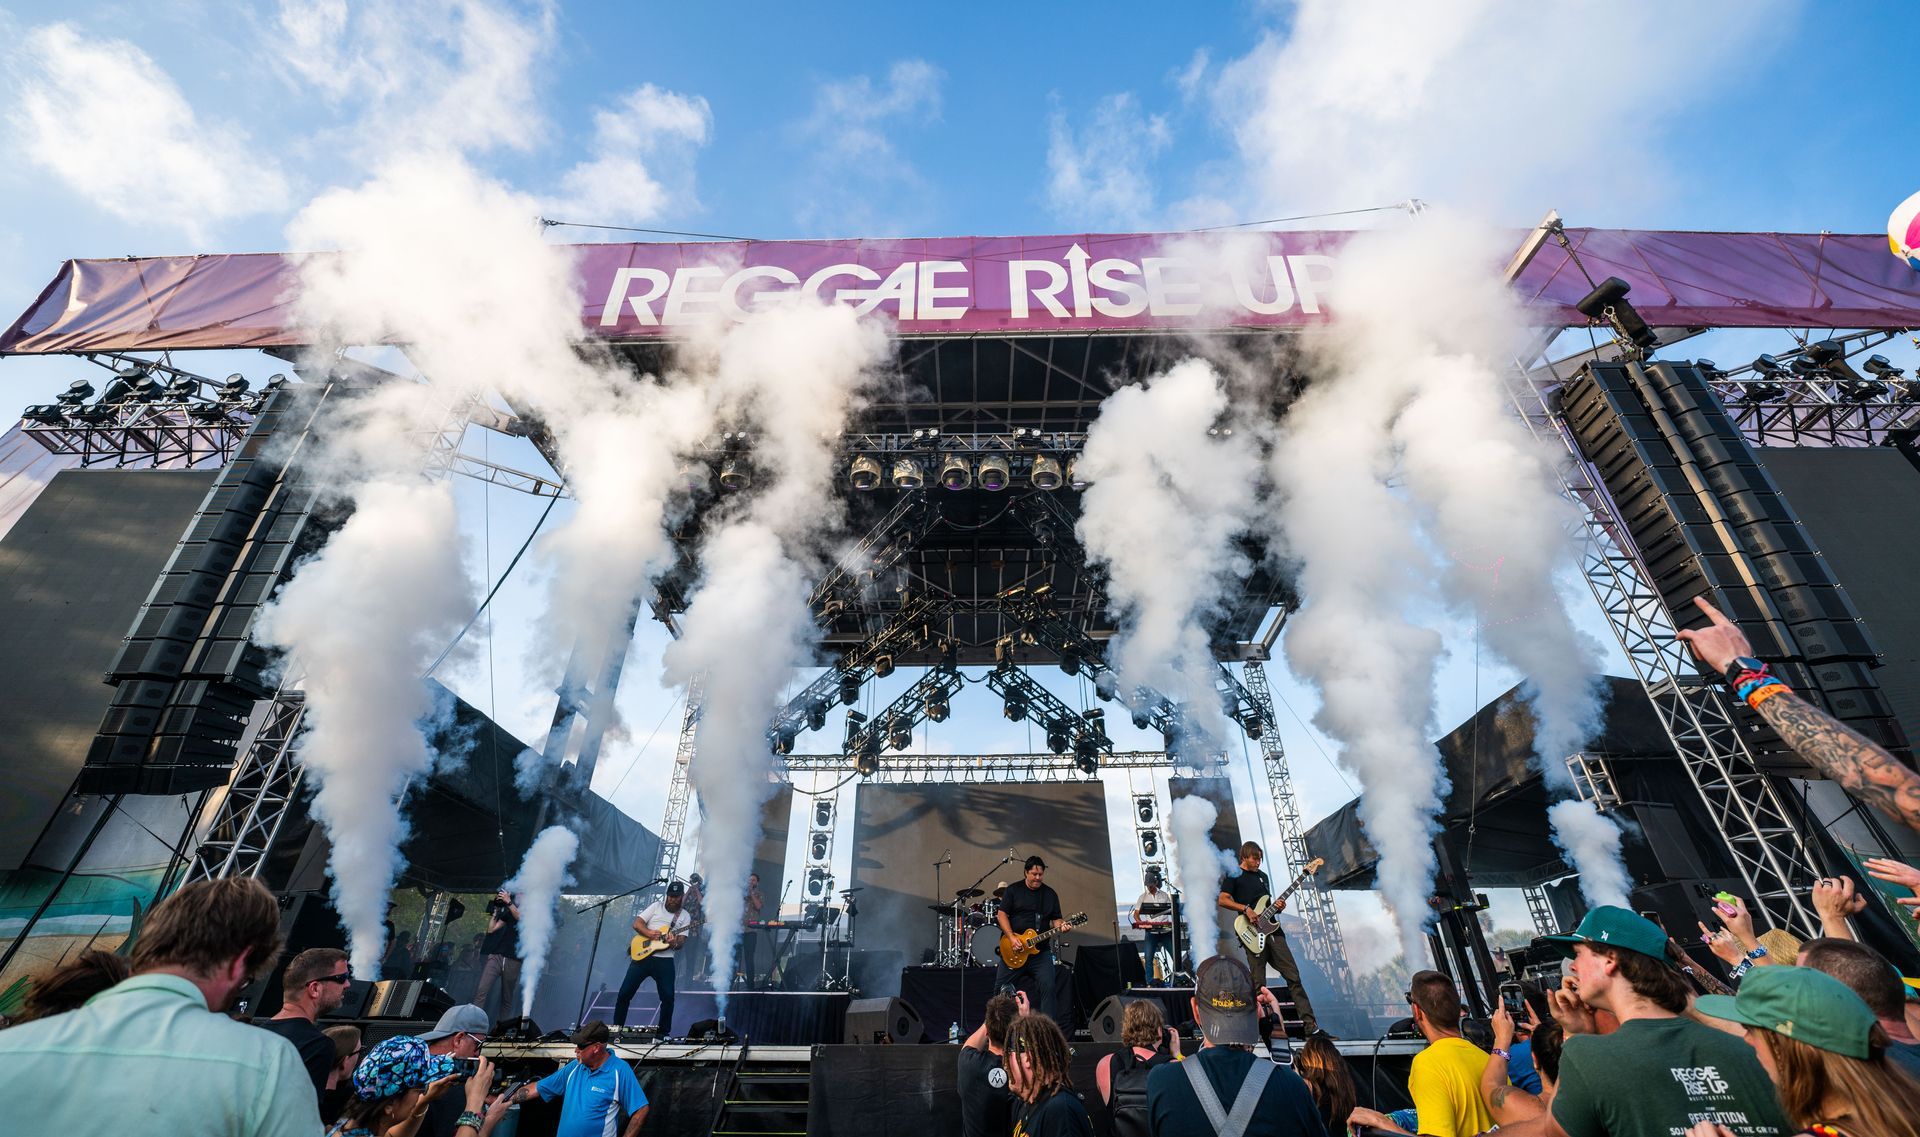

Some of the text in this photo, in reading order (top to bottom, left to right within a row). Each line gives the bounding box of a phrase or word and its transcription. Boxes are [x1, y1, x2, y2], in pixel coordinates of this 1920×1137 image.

[600, 243, 1340, 327] REGGAE RISE UP
[1670, 1066, 1720, 1081] REGGAE
[1682, 1077, 1729, 1095] RISE UP
[1738, 1126, 1755, 1134] THE
